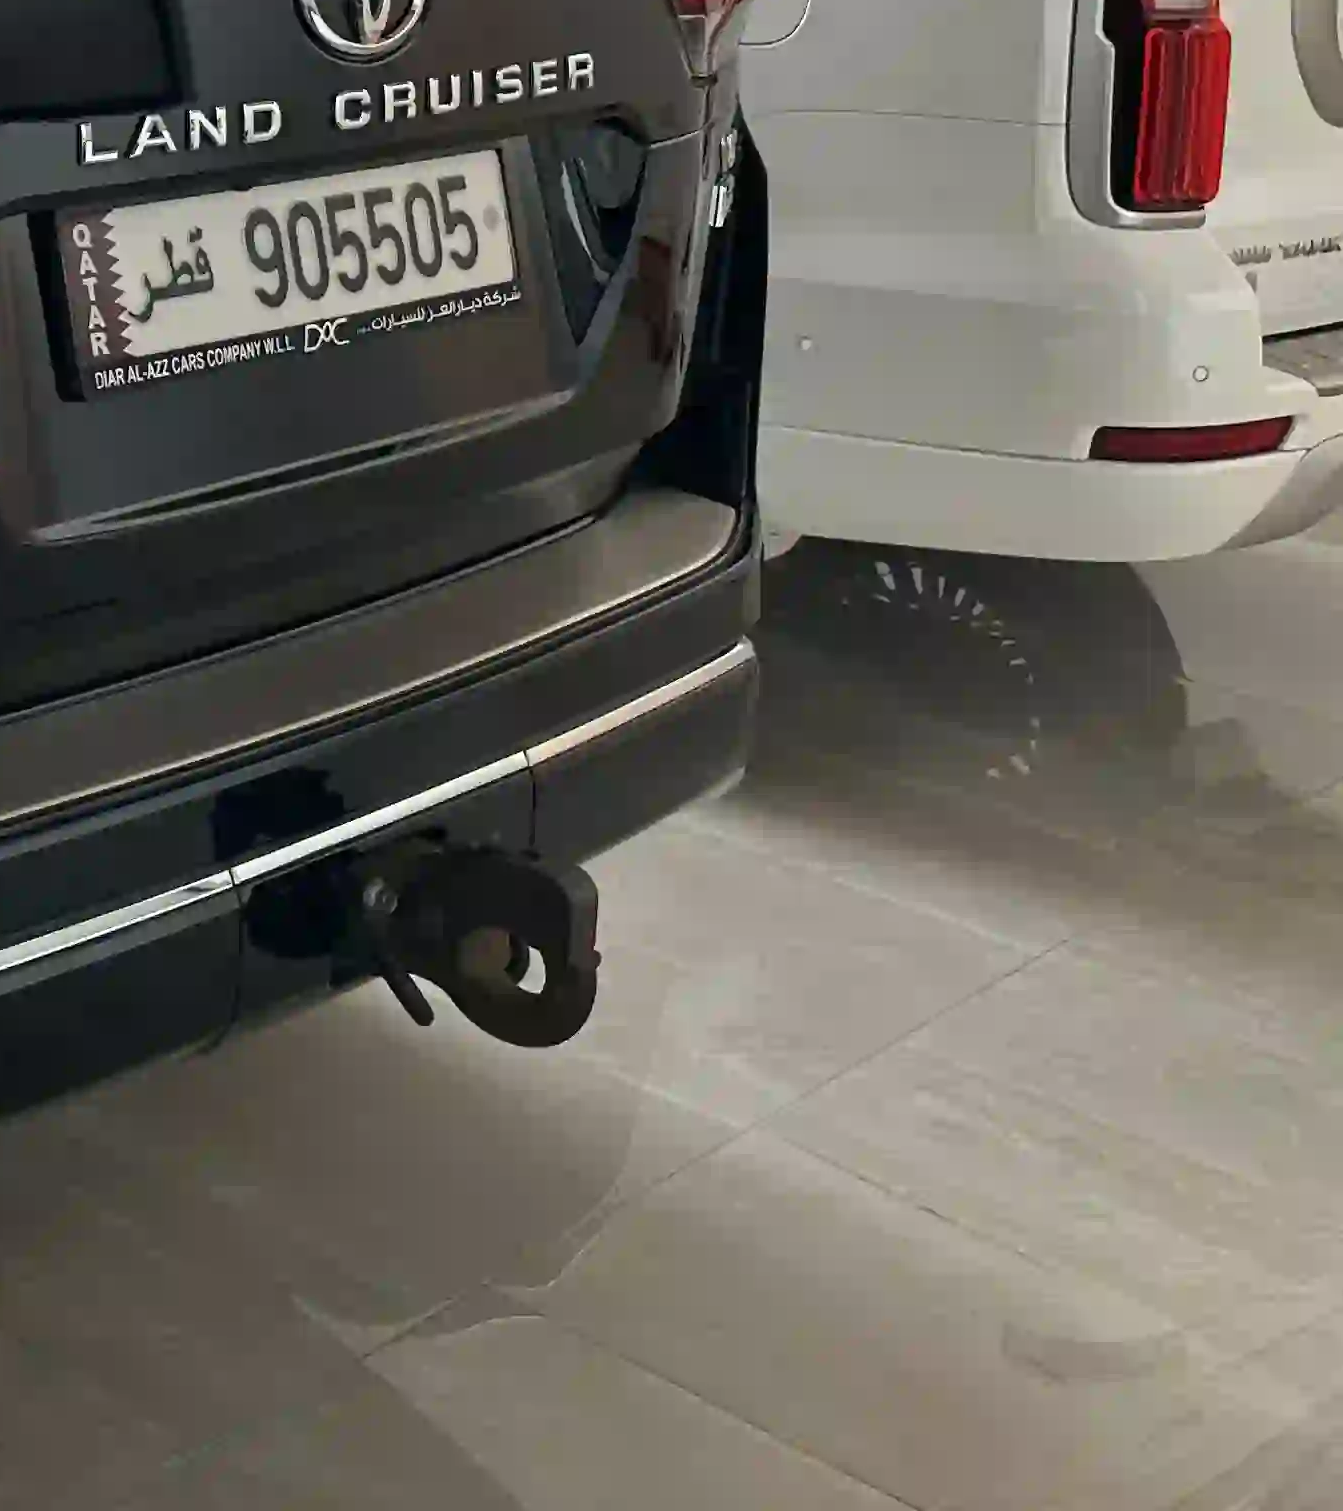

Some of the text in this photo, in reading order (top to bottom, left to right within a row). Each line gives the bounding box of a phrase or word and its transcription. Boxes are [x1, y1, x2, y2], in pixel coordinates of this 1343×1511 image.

[79, 51, 596, 166] LAND CRUISER
[72, 222, 111, 358] QATAR
[127, 225, 214, 324] قطر
[243, 174, 480, 309] 905505
[482, 285, 522, 307] شركة
[94, 367, 126, 390] DIAR
[127, 358, 171, 383] AL-AZZ
[171, 351, 206, 375] CARS
[206, 338, 263, 368] COMPANY
